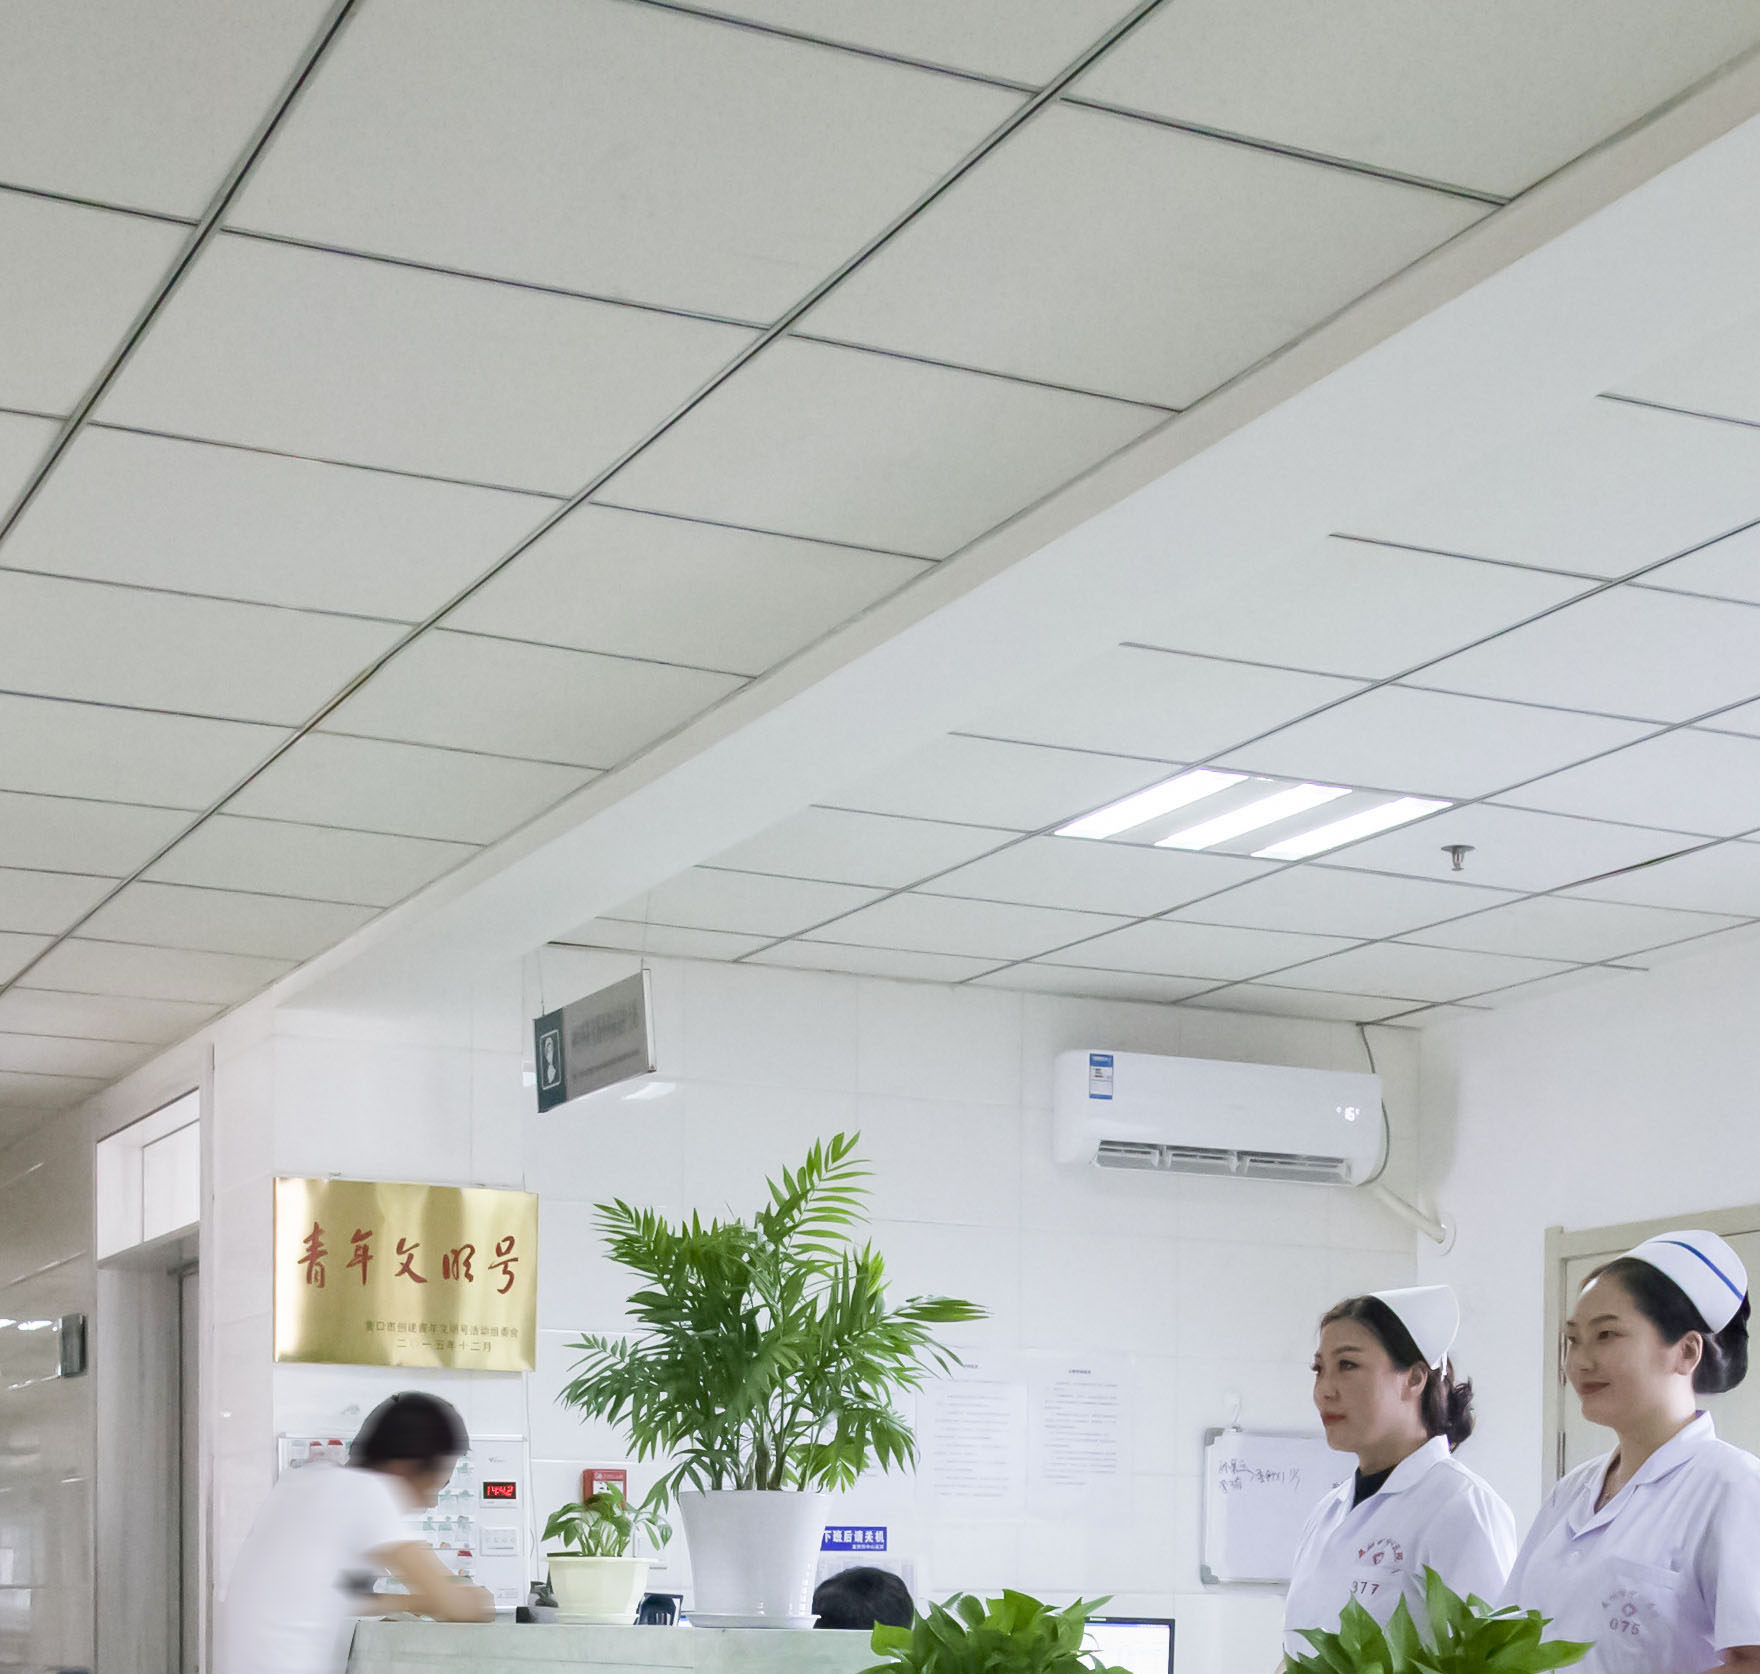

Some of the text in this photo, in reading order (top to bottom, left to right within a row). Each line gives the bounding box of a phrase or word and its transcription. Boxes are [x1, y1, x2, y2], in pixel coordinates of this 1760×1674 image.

[297, 1221, 519, 1295] 青年文明号
[396, 1338, 491, 1352] 二一五年十二月
[824, 1530, 885, 1543] 下班后请关机
